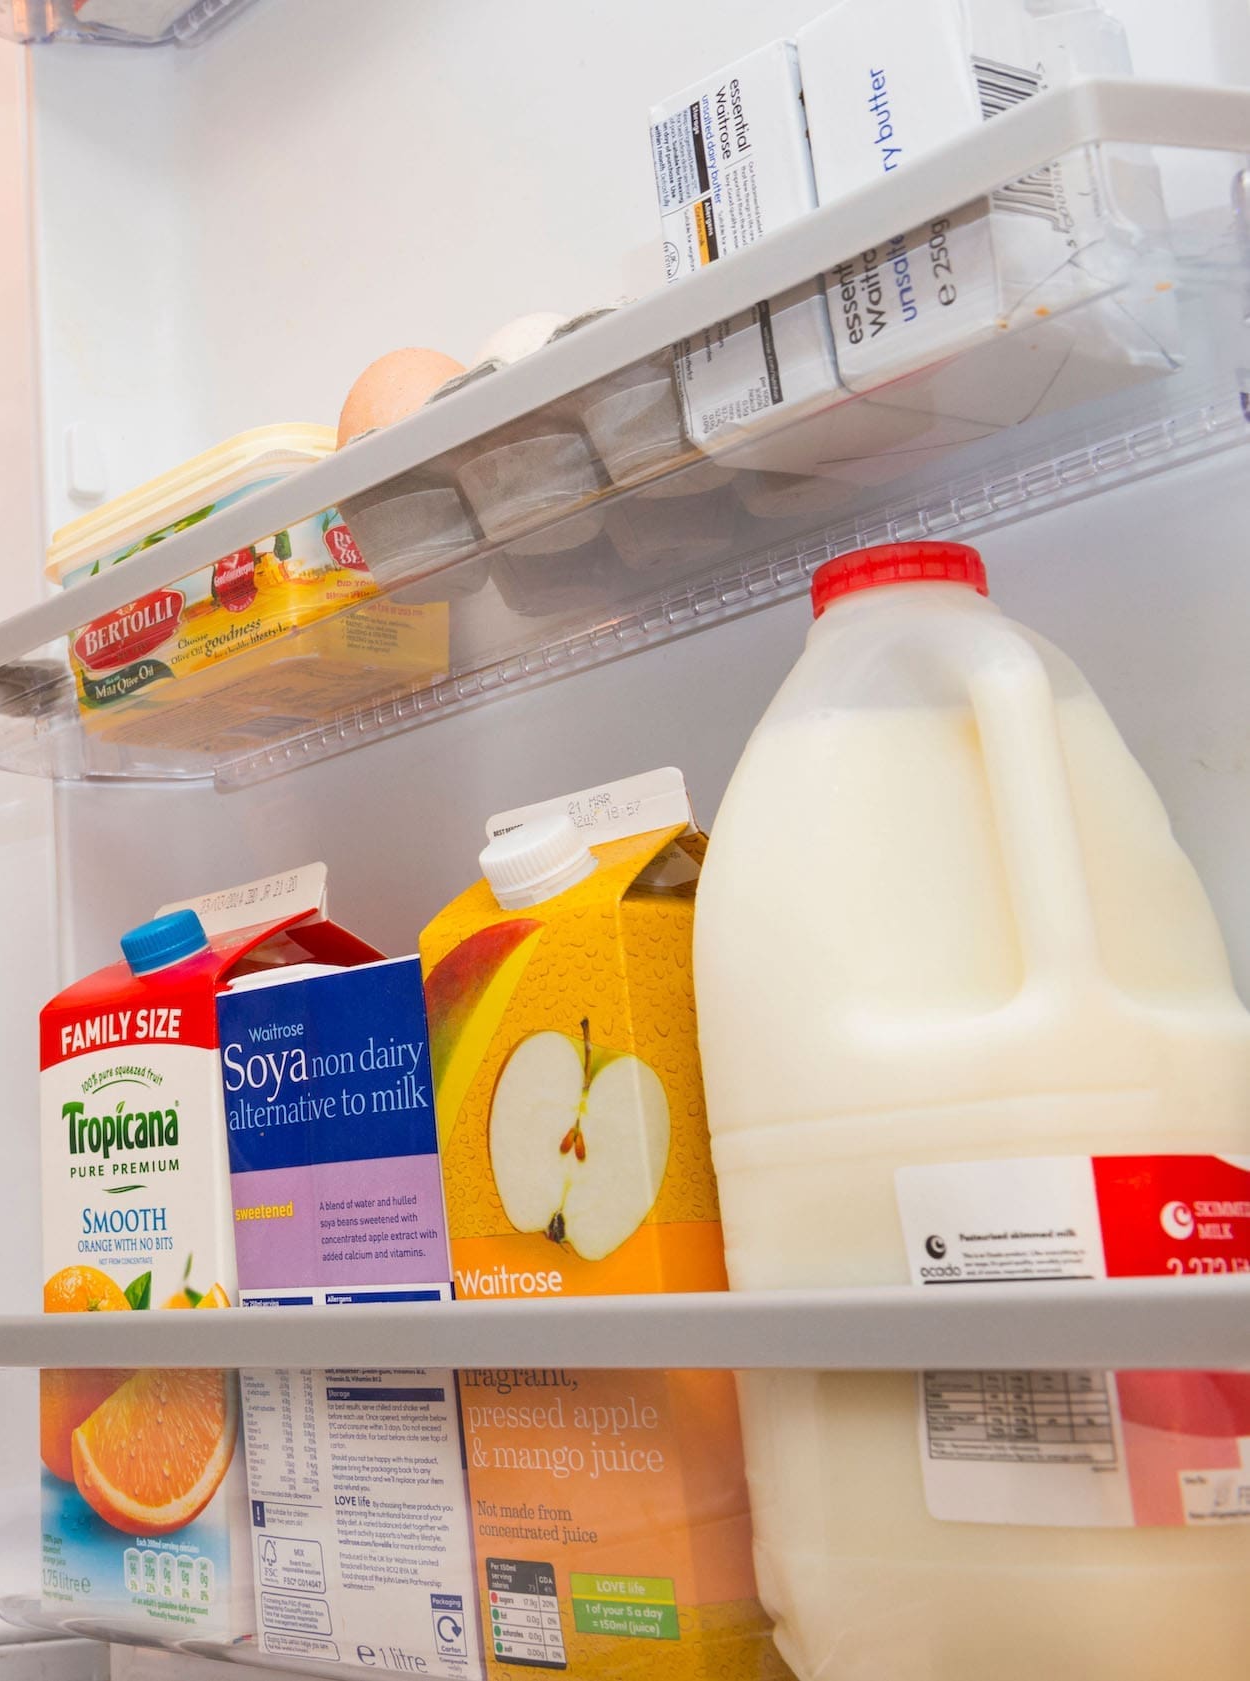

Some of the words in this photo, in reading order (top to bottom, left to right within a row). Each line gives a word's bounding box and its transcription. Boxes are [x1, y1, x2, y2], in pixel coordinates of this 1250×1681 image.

[729, 78, 750, 153] essential
[868, 69, 894, 144] butter
[691, 104, 700, 135] Storage
[701, 94, 713, 140] unsalted
[716, 85, 732, 160] Waitrose
[707, 140, 718, 170] dairy
[711, 170, 722, 204] butter
[703, 202, 714, 237] Allergens
[929, 218, 953, 279] 250g
[85, 597, 174, 657] BERTOLLI
[170, 651, 190, 666] Olive
[190, 646, 204, 658] Oil
[204, 618, 263, 658] goodness
[177, 632, 209, 650] Choose
[95, 684, 117, 699] Mild
[117, 675, 139, 696] Olive
[139, 664, 155, 680] Oil
[567, 802, 581, 815] 21
[493, 828, 506, 837] BEST
[61, 1011, 131, 1056] FAMILY
[135, 1008, 182, 1038] SIZE
[249, 1020, 305, 1043] Waitrose
[81, 1072, 97, 1094] 100%
[98, 1067, 114, 1084] pure
[115, 1066, 146, 1078] squeezed
[148, 1069, 163, 1086] fruit
[223, 1042, 310, 1104] Soya
[311, 1052, 356, 1078] non
[359, 1037, 425, 1078] dairy
[228, 1087, 336, 1131] alternative
[342, 1084, 367, 1106] to
[372, 1074, 429, 1113] milk
[61, 1101, 179, 1159] Tropicana
[70, 1165, 104, 1178] PURE
[113, 1159, 179, 1175] PREMIUM
[234, 1201, 294, 1222] sweetened
[320, 1202, 324, 1211] A
[326, 1202, 345, 1210] blend
[346, 1200, 354, 1209] of
[354, 1200, 376, 1208] water
[377, 1197, 391, 1207] and
[392, 1195, 417, 1205] hulled
[83, 1208, 167, 1234] SMOOTH
[320, 1220, 335, 1229] soya
[337, 1218, 358, 1227] beans
[360, 1214, 399, 1225] sweetened
[401, 1213, 418, 1222] with
[1197, 1222, 1234, 1240] MILK
[321, 1233, 367, 1244] concentrated
[368, 1232, 388, 1244] apple
[391, 1231, 418, 1240] extract
[420, 1229, 438, 1239] with
[1011, 1230, 1053, 1239] skimmed
[1056, 1228, 1077, 1238] milk
[78, 1240, 112, 1252] ORANGE
[114, 1238, 137, 1251] WITH
[140, 1237, 153, 1250] NO
[155, 1237, 173, 1250] BITS
[109, 1257, 121, 1265] FROM
[121, 1256, 153, 1265] CONCENTRATE
[322, 1252, 343, 1261] added
[345, 1250, 373, 1260] calcium
[375, 1249, 389, 1259] and
[390, 1249, 426, 1257] vitamins.
[920, 1264, 962, 1277] ocado
[455, 1268, 563, 1295] Waitrose
[326, 1295, 352, 1304] Allergens
[464, 1369, 578, 1395] fragrant,
[468, 1397, 566, 1434] pressed
[574, 1397, 658, 1436] apple
[472, 1437, 489, 1469] &
[493, 1445, 584, 1479] mango
[590, 1441, 664, 1479] juice
[334, 1496, 357, 1506] LOVE
[357, 1496, 370, 1507] life
[477, 1500, 497, 1517] Not
[500, 1503, 534, 1520] made
[538, 1504, 573, 1521] from
[479, 1522, 560, 1541] concentrated
[562, 1525, 598, 1545] juice
[264, 1568, 278, 1577] FSC
[490, 1562, 499, 1570] Per
[499, 1564, 516, 1572] 150ml
[491, 1572, 512, 1582] serving
[59, 1572, 80, 1592] litre
[163, 1568, 171, 1582] 0g
[181, 1571, 190, 1585] 0g
[200, 1573, 208, 1588] 0g
[538, 1576, 553, 1584] GDA
[596, 1580, 626, 1594] LOVE
[628, 1582, 646, 1595] life
[432, 1598, 461, 1608] Packaging
[585, 1604, 590, 1612] 1
[591, 1603, 601, 1614] of
[602, 1605, 623, 1617] your
[627, 1606, 632, 1615] 5
[635, 1609, 642, 1617] a
[643, 1608, 663, 1619] day
[547, 1617, 557, 1625] 0%
[600, 1619, 627, 1632] 150ml
[629, 1623, 660, 1637] (juice)
[550, 1634, 559, 1643] 0%
[357, 1645, 376, 1665] e
[379, 1647, 389, 1668] 1
[389, 1647, 428, 1673] litre
[441, 1645, 461, 1653] Carton
[552, 1650, 562, 1659] 0%
